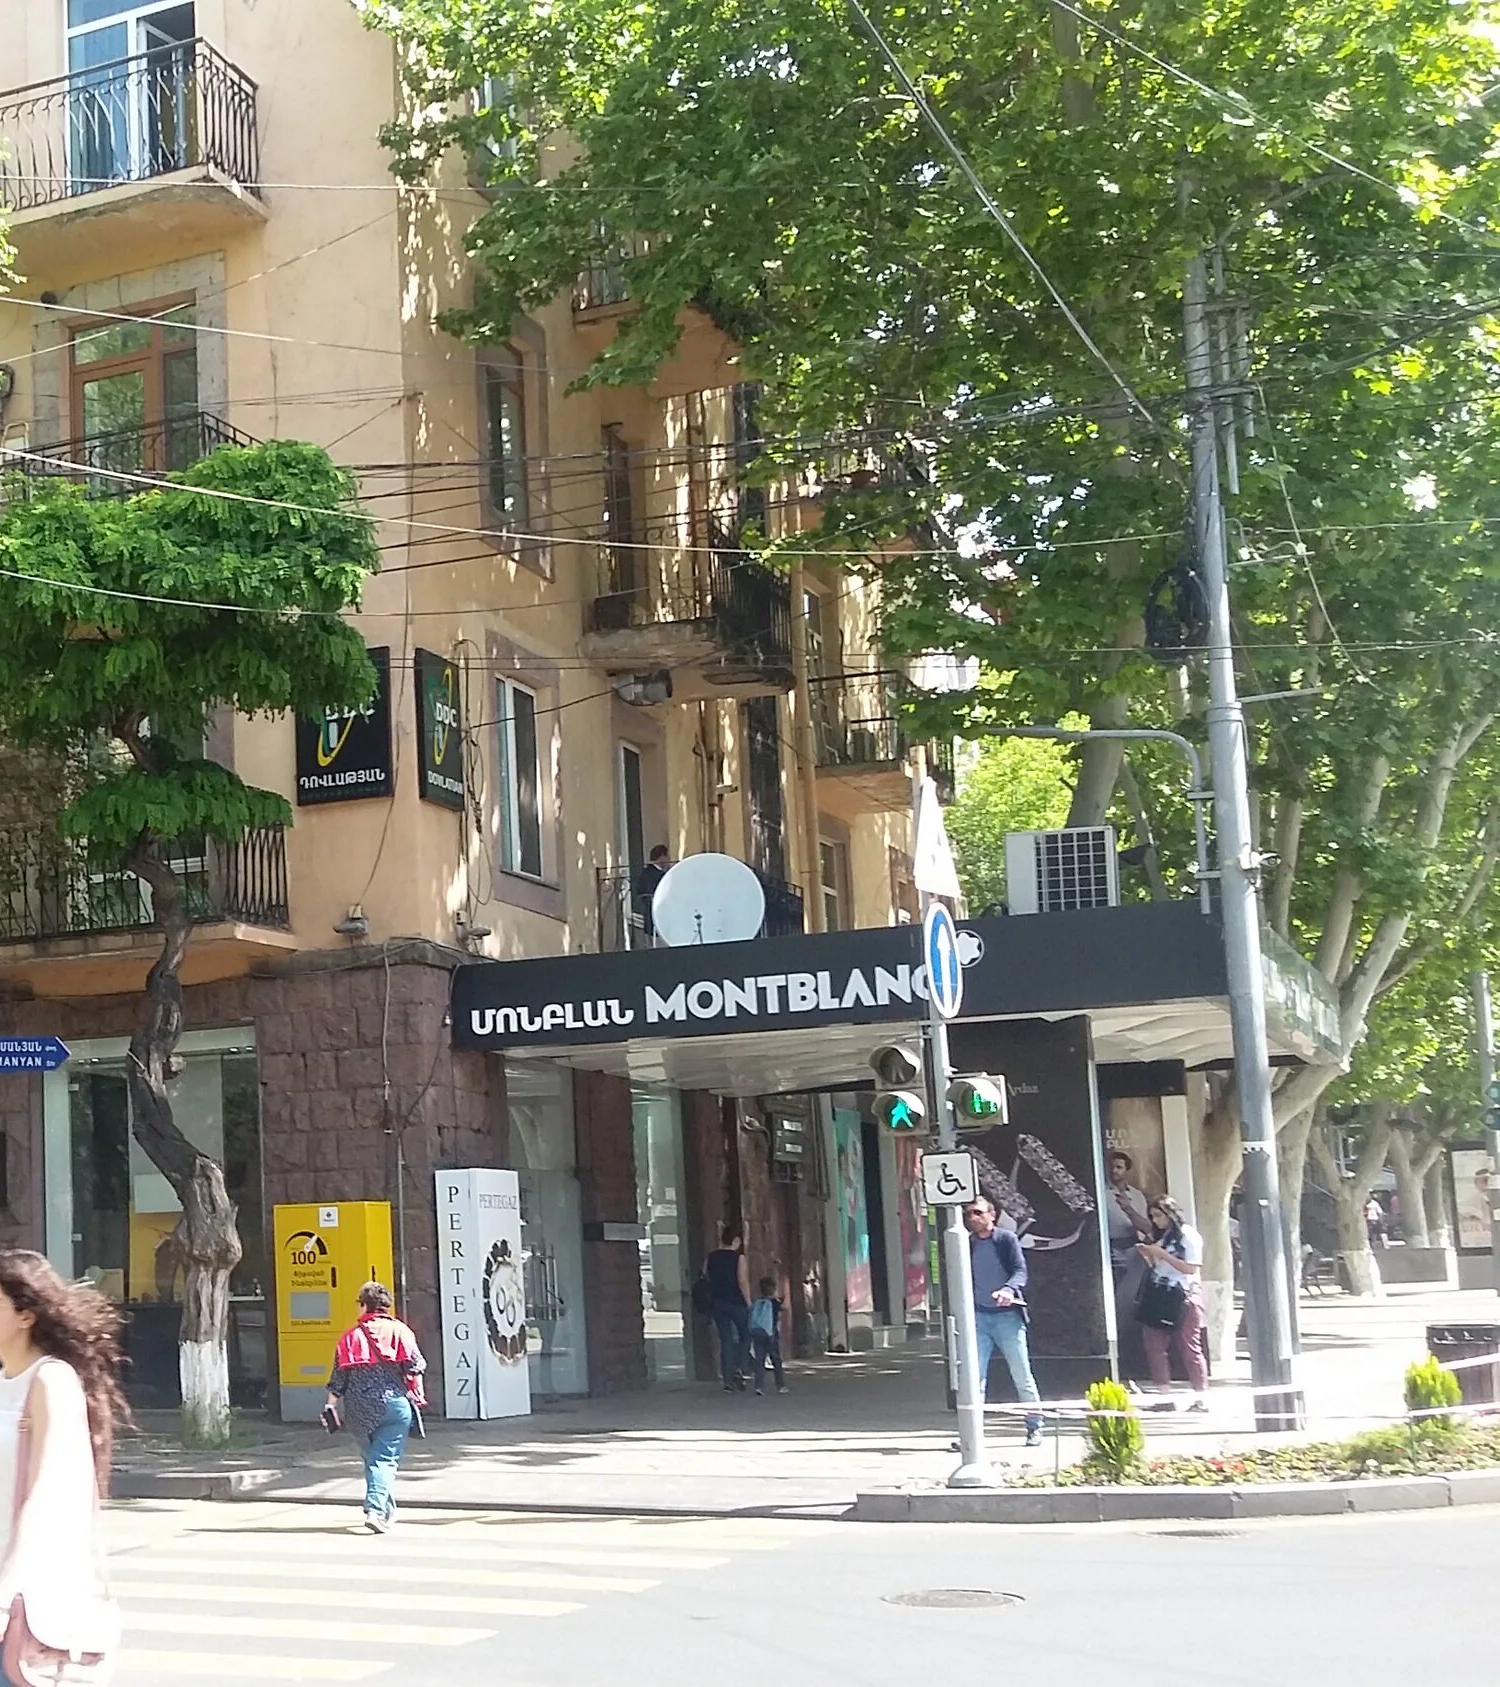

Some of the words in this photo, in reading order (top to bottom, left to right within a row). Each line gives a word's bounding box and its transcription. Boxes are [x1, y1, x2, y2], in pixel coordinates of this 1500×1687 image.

[436, 701, 457, 727] DDC
[300, 768, 385, 789] ԴՈՎԼԱԹՅԱՆ
[471, 999, 634, 1035] ՄՈՆԲԼԱՆ
[479, 1194, 518, 1210] PERTEGAZ
[291, 1250, 317, 1265] 100
[448, 1186, 472, 1397] PERTEGAZ
